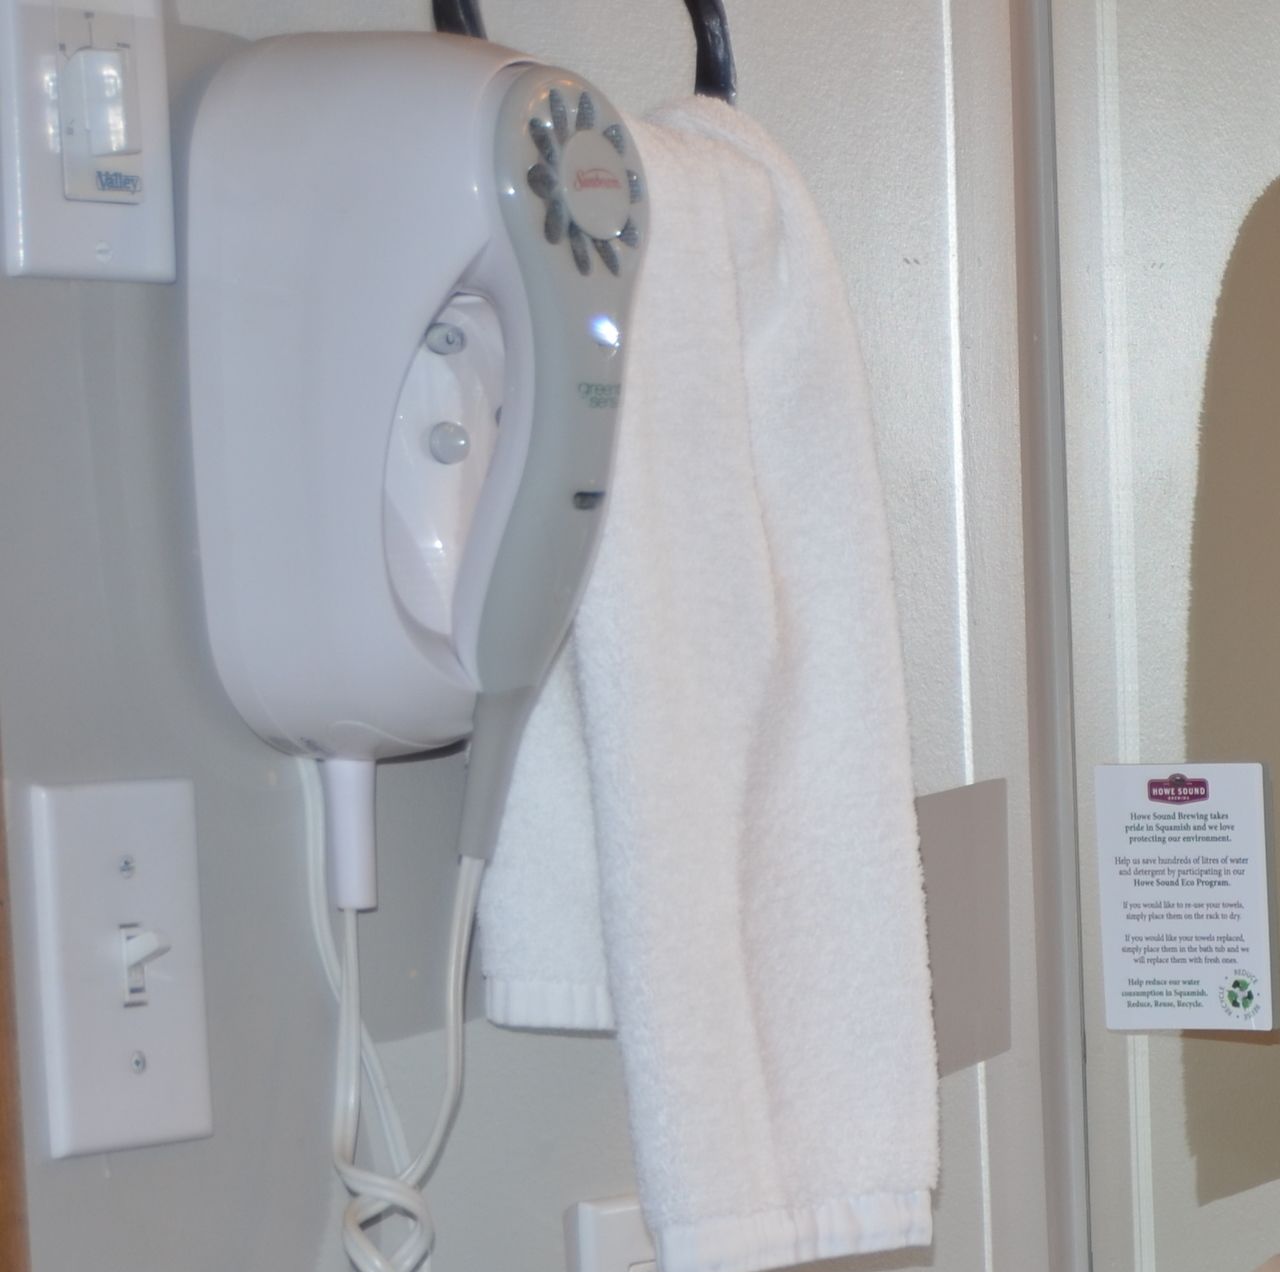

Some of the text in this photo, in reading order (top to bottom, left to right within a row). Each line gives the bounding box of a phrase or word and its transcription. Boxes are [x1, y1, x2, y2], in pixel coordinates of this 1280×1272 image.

[95, 170, 141, 193] Valley
[1152, 787, 1206, 796] HOWE SOUND
[1130, 811, 1229, 823] Howe Sound Brewing takes
[1125, 823, 1144, 834] pride
[1146, 823, 1153, 832] in
[1155, 823, 1191, 833] Squamish
[1193, 823, 1206, 831] and
[1220, 823, 1235, 831] love
[1129, 834, 1167, 845] protecting
[1182, 834, 1232, 842] environment.
[1114, 856, 1131, 867] Help
[1158, 856, 1191, 865] hundreds
[1193, 856, 1200, 865] of
[1201, 856, 1219, 865] litres
[1220, 856, 1229, 865] of
[1230, 857, 1248, 865] water
[1119, 867, 1131, 876] and
[1133, 867, 1166, 877] detergent
[1167, 867, 1176, 877] by
[1177, 867, 1222, 878] participating
[1223, 867, 1231, 876] in
[1134, 878, 1231, 888] Howe Sound Eco Program.
[1128, 978, 1143, 987] Help
[1145, 978, 1167, 986] reduce
[1182, 978, 1200, 986] water
[1121, 989, 1208, 999] consumption in Squamish.
[1127, 1000, 1204, 1009] Reduce, Reuse, Recycle.
